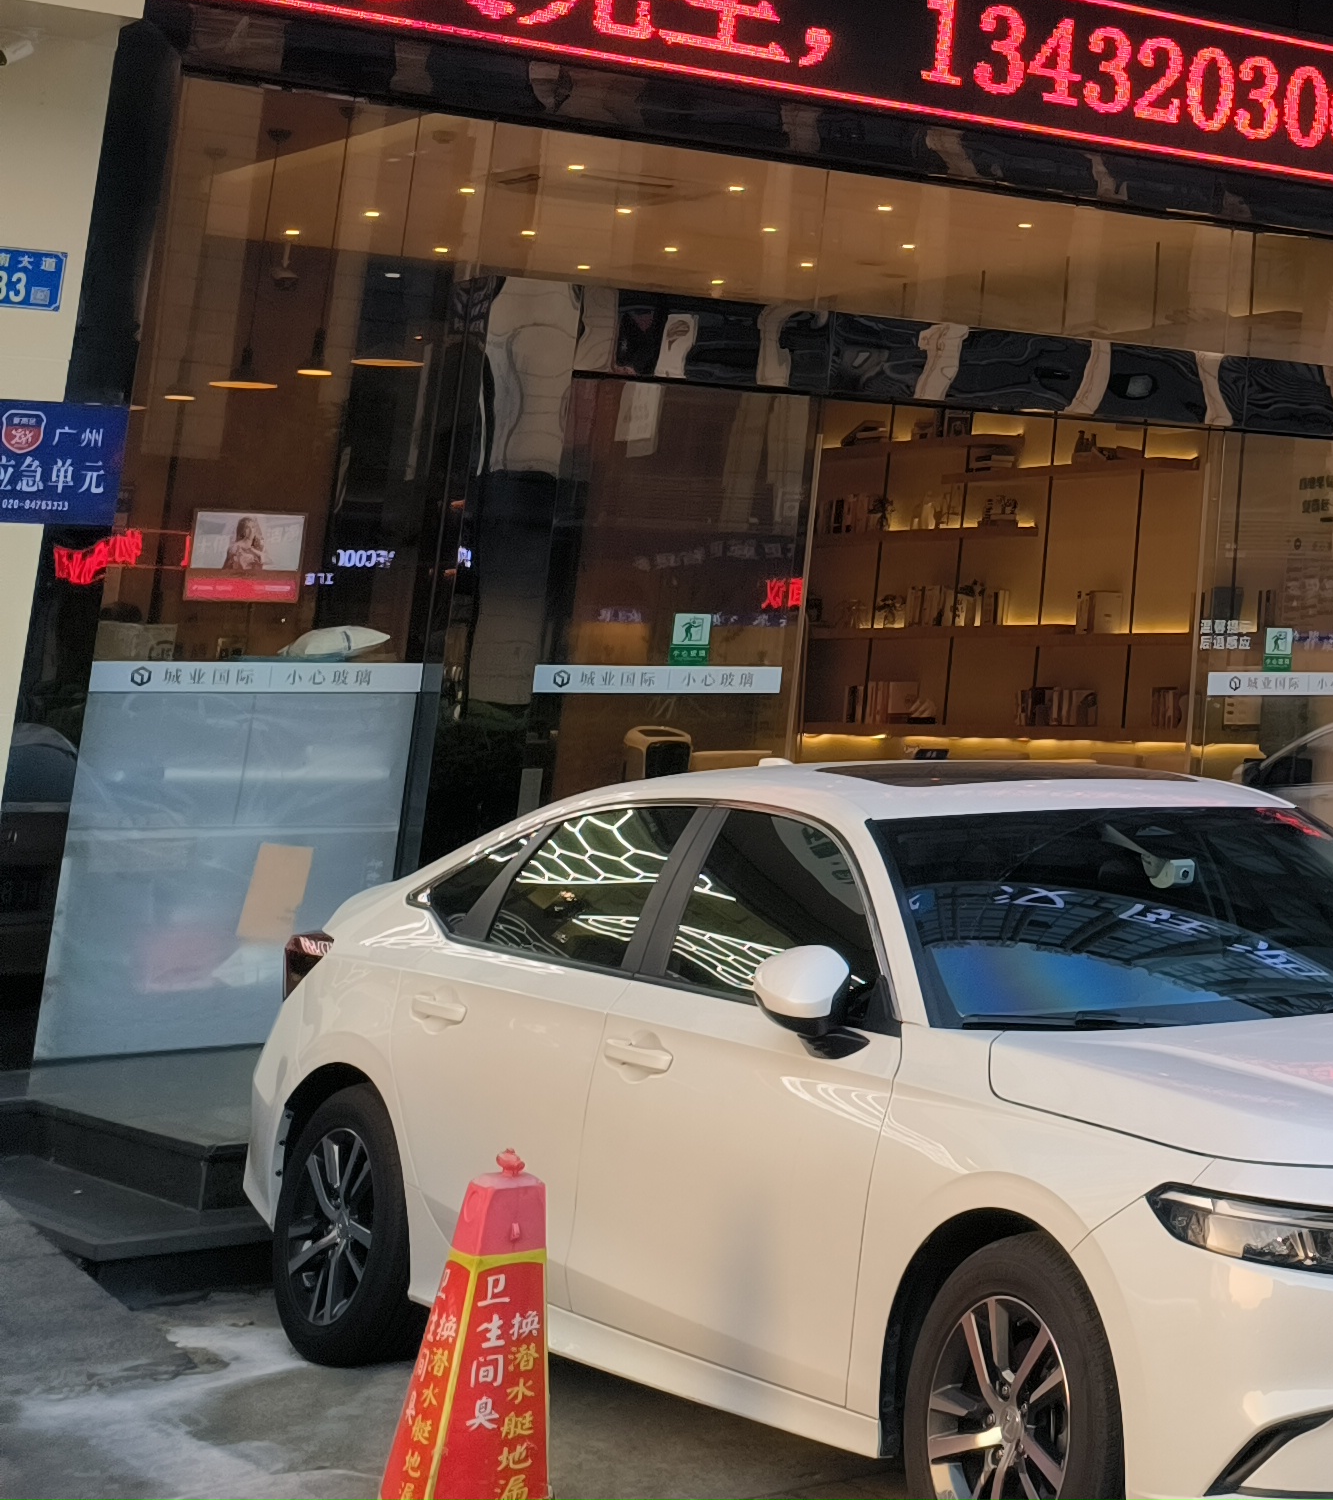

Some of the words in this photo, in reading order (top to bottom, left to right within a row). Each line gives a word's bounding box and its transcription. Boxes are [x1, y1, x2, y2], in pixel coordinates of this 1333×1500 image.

[52, 425, 104, 448] 广州
[284, 668, 372, 687] 小心玻璃
[681, 671, 755, 688] 小心玻璃
[466, 1273, 510, 1432] 卫生间臭
